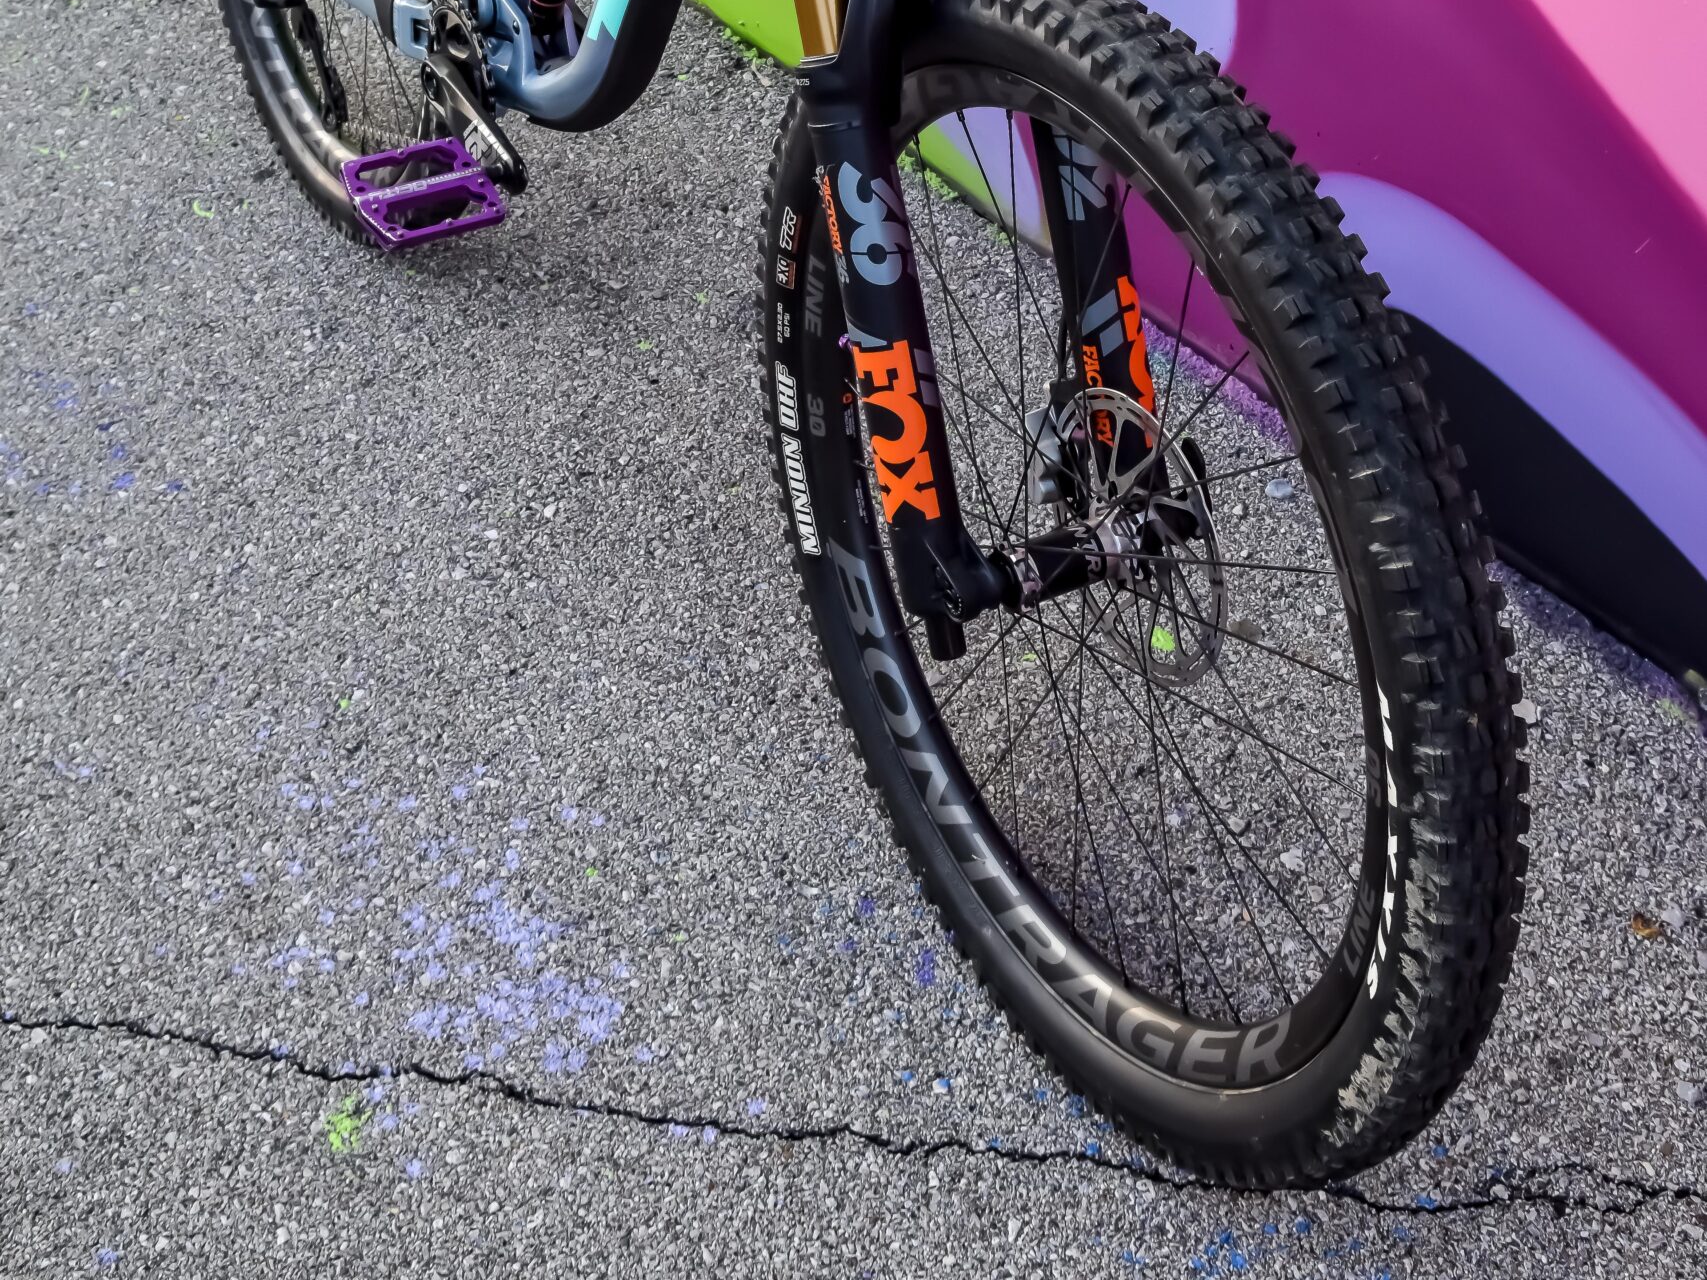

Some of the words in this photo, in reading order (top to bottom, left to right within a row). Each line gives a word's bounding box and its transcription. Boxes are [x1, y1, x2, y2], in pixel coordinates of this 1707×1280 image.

[779, 206, 796, 251] TR
[837, 161, 914, 286] 36
[805, 253, 827, 337] LINE
[775, 361, 799, 431] DHF
[807, 393, 827, 437] 30
[852, 339, 941, 524] FOX
[781, 433, 821, 556] MINION
[827, 536, 1292, 1083] BONTRAGER
[1343, 880, 1376, 978] LINE
